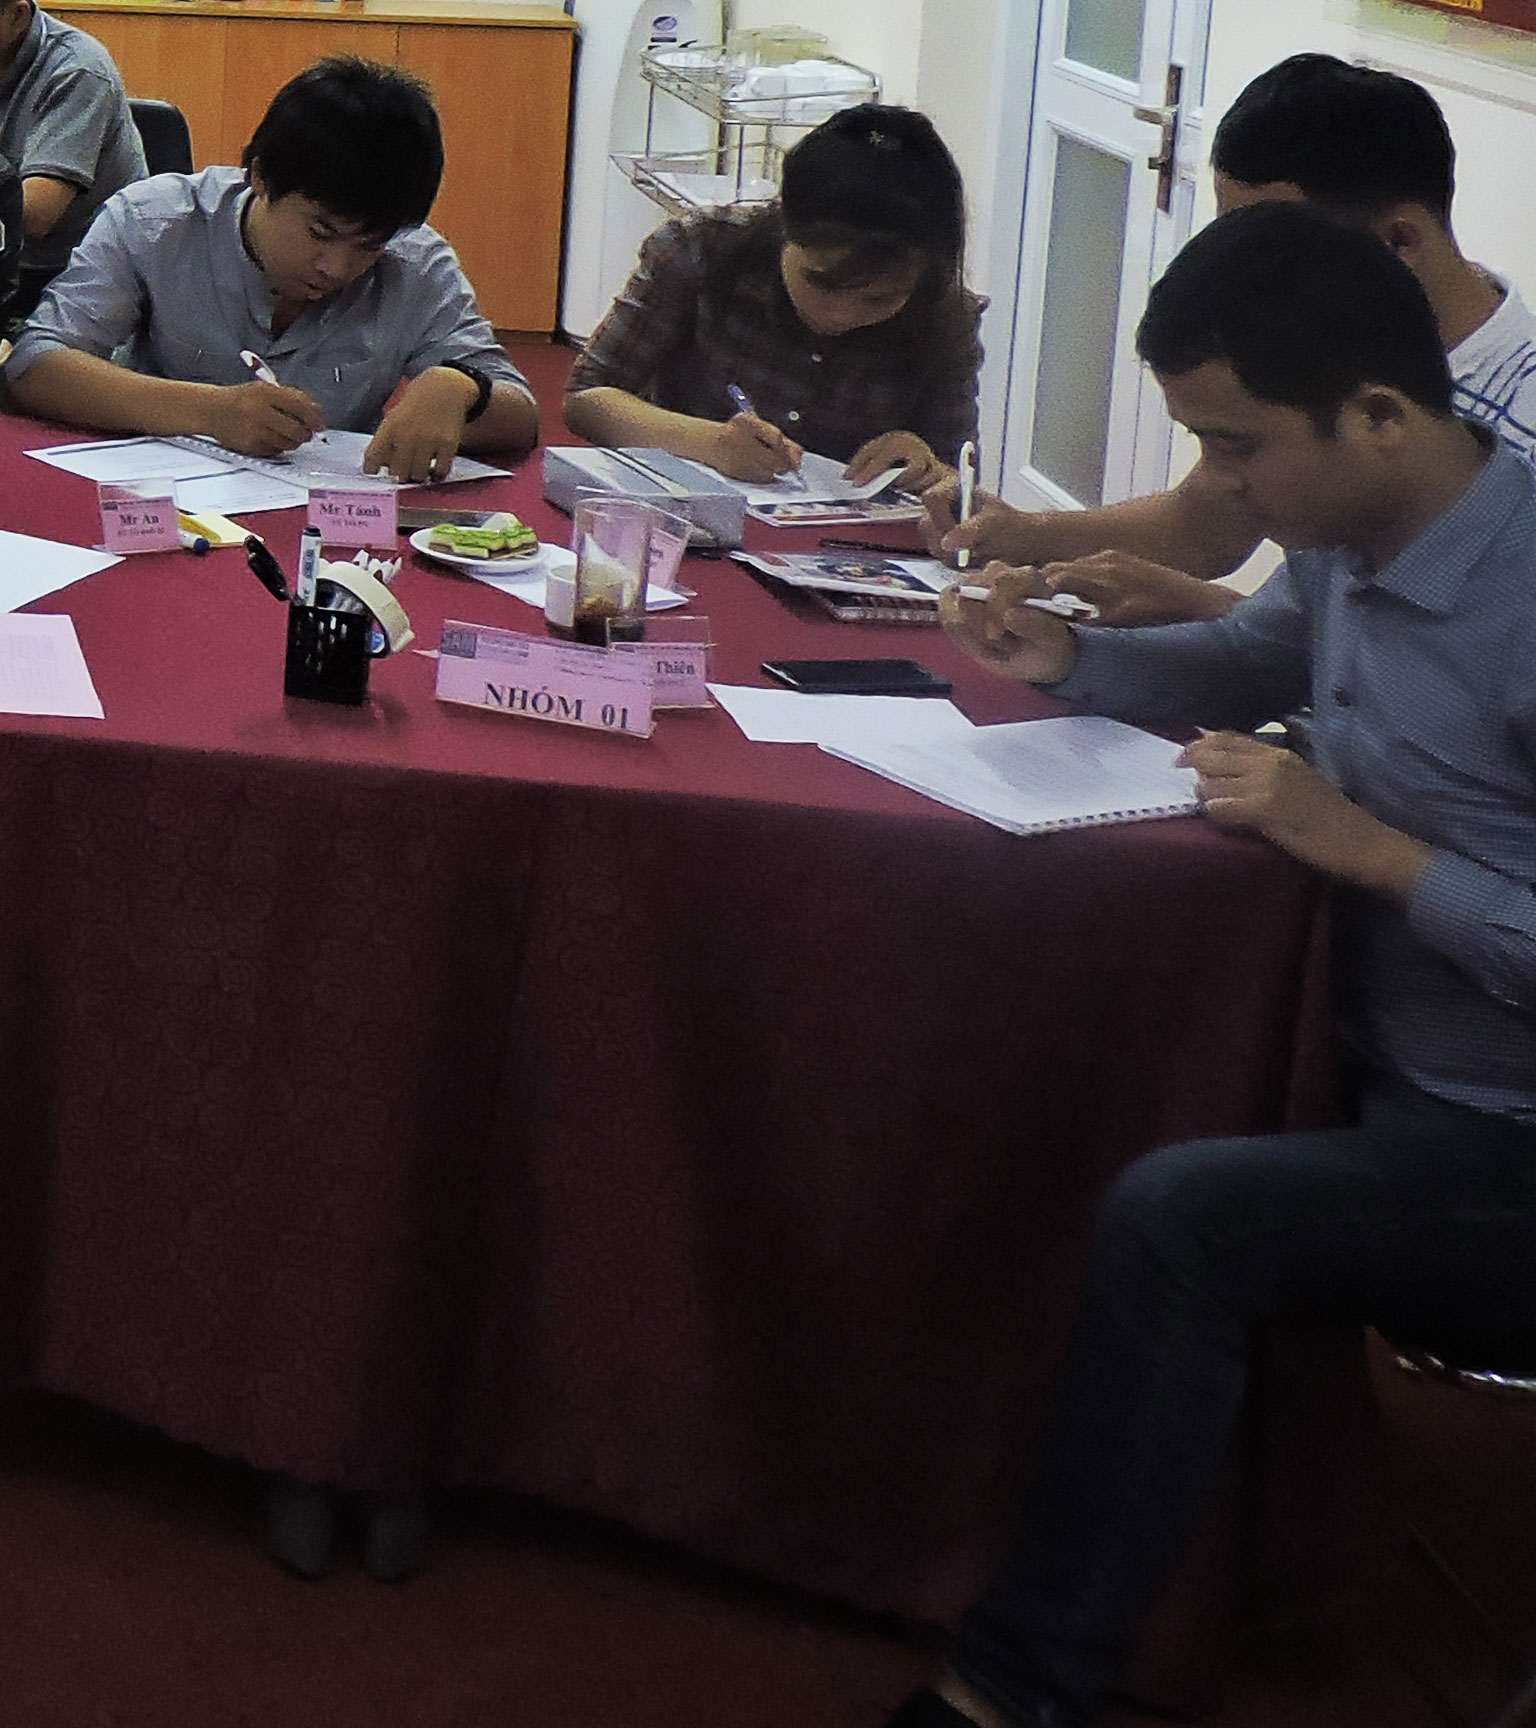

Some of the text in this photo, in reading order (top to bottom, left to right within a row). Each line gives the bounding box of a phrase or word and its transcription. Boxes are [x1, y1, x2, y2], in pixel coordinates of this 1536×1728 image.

[320, 503, 340, 515] Mr
[120, 514, 160, 525] Mr An
[655, 659, 695, 674] Thiên
[484, 682, 629, 729] NHÓM 01
